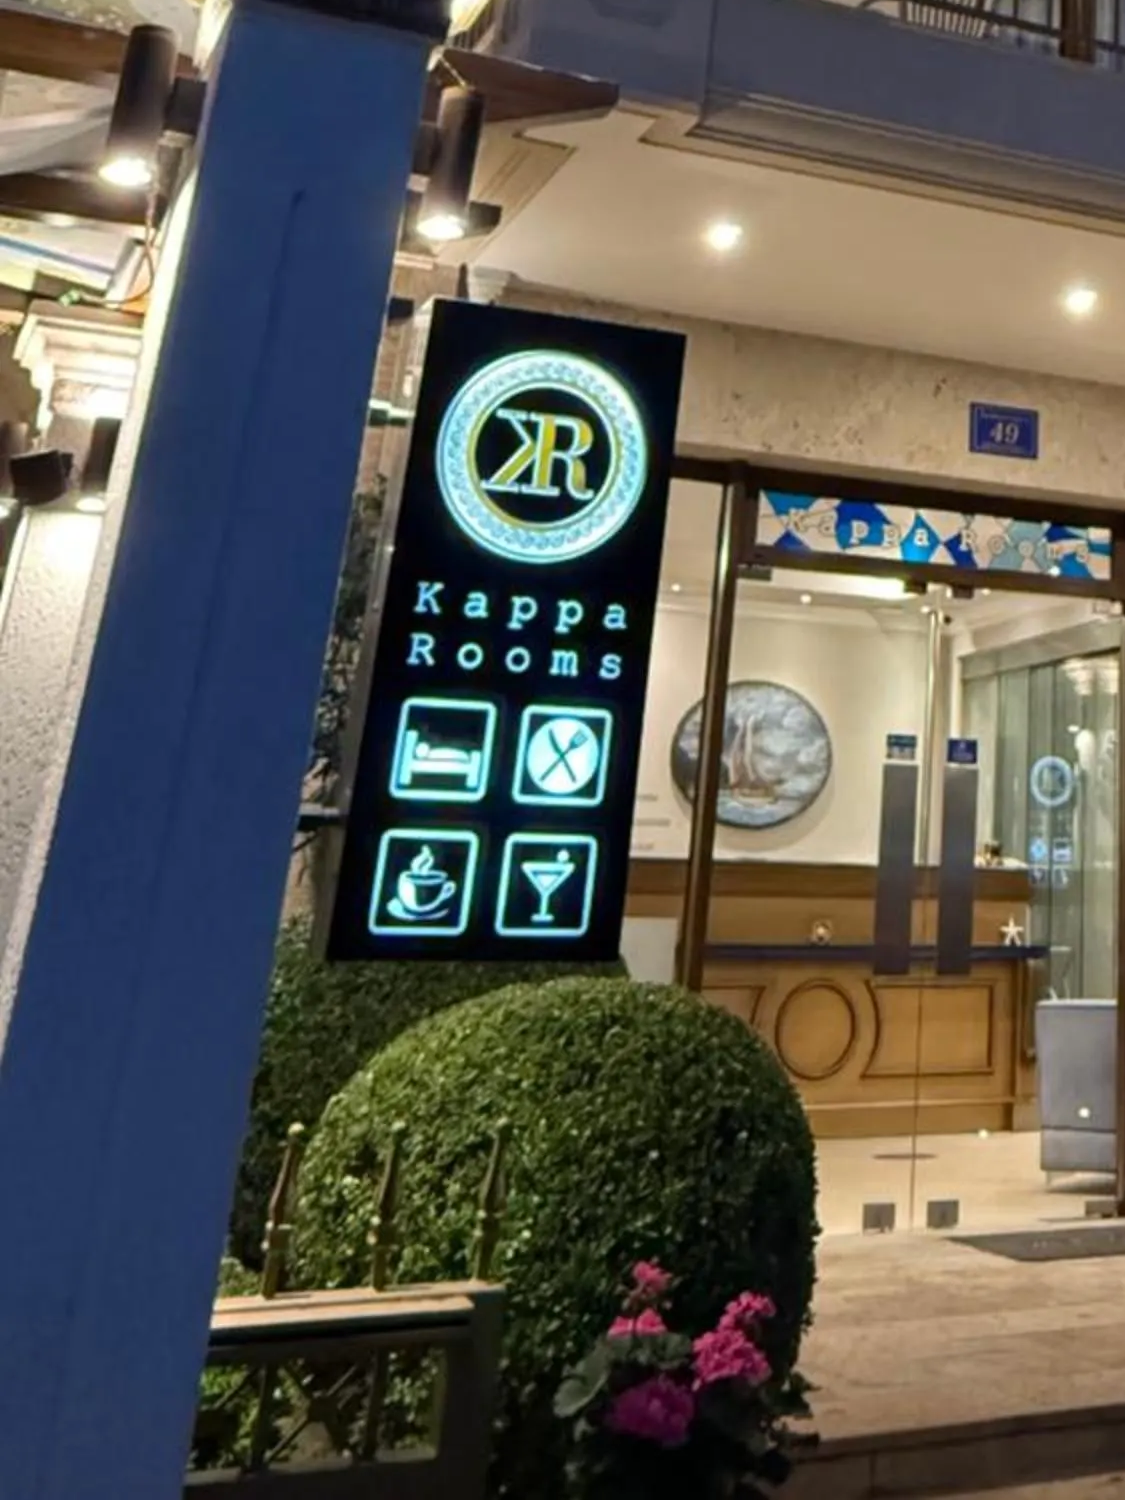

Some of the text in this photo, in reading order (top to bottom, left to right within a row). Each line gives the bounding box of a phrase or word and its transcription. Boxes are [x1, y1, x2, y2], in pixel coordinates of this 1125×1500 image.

[989, 421, 1019, 444] 49
[788, 508, 931, 547] Kappa
[413, 580, 627, 634] Kappa
[406, 632, 622, 679] Rooms
